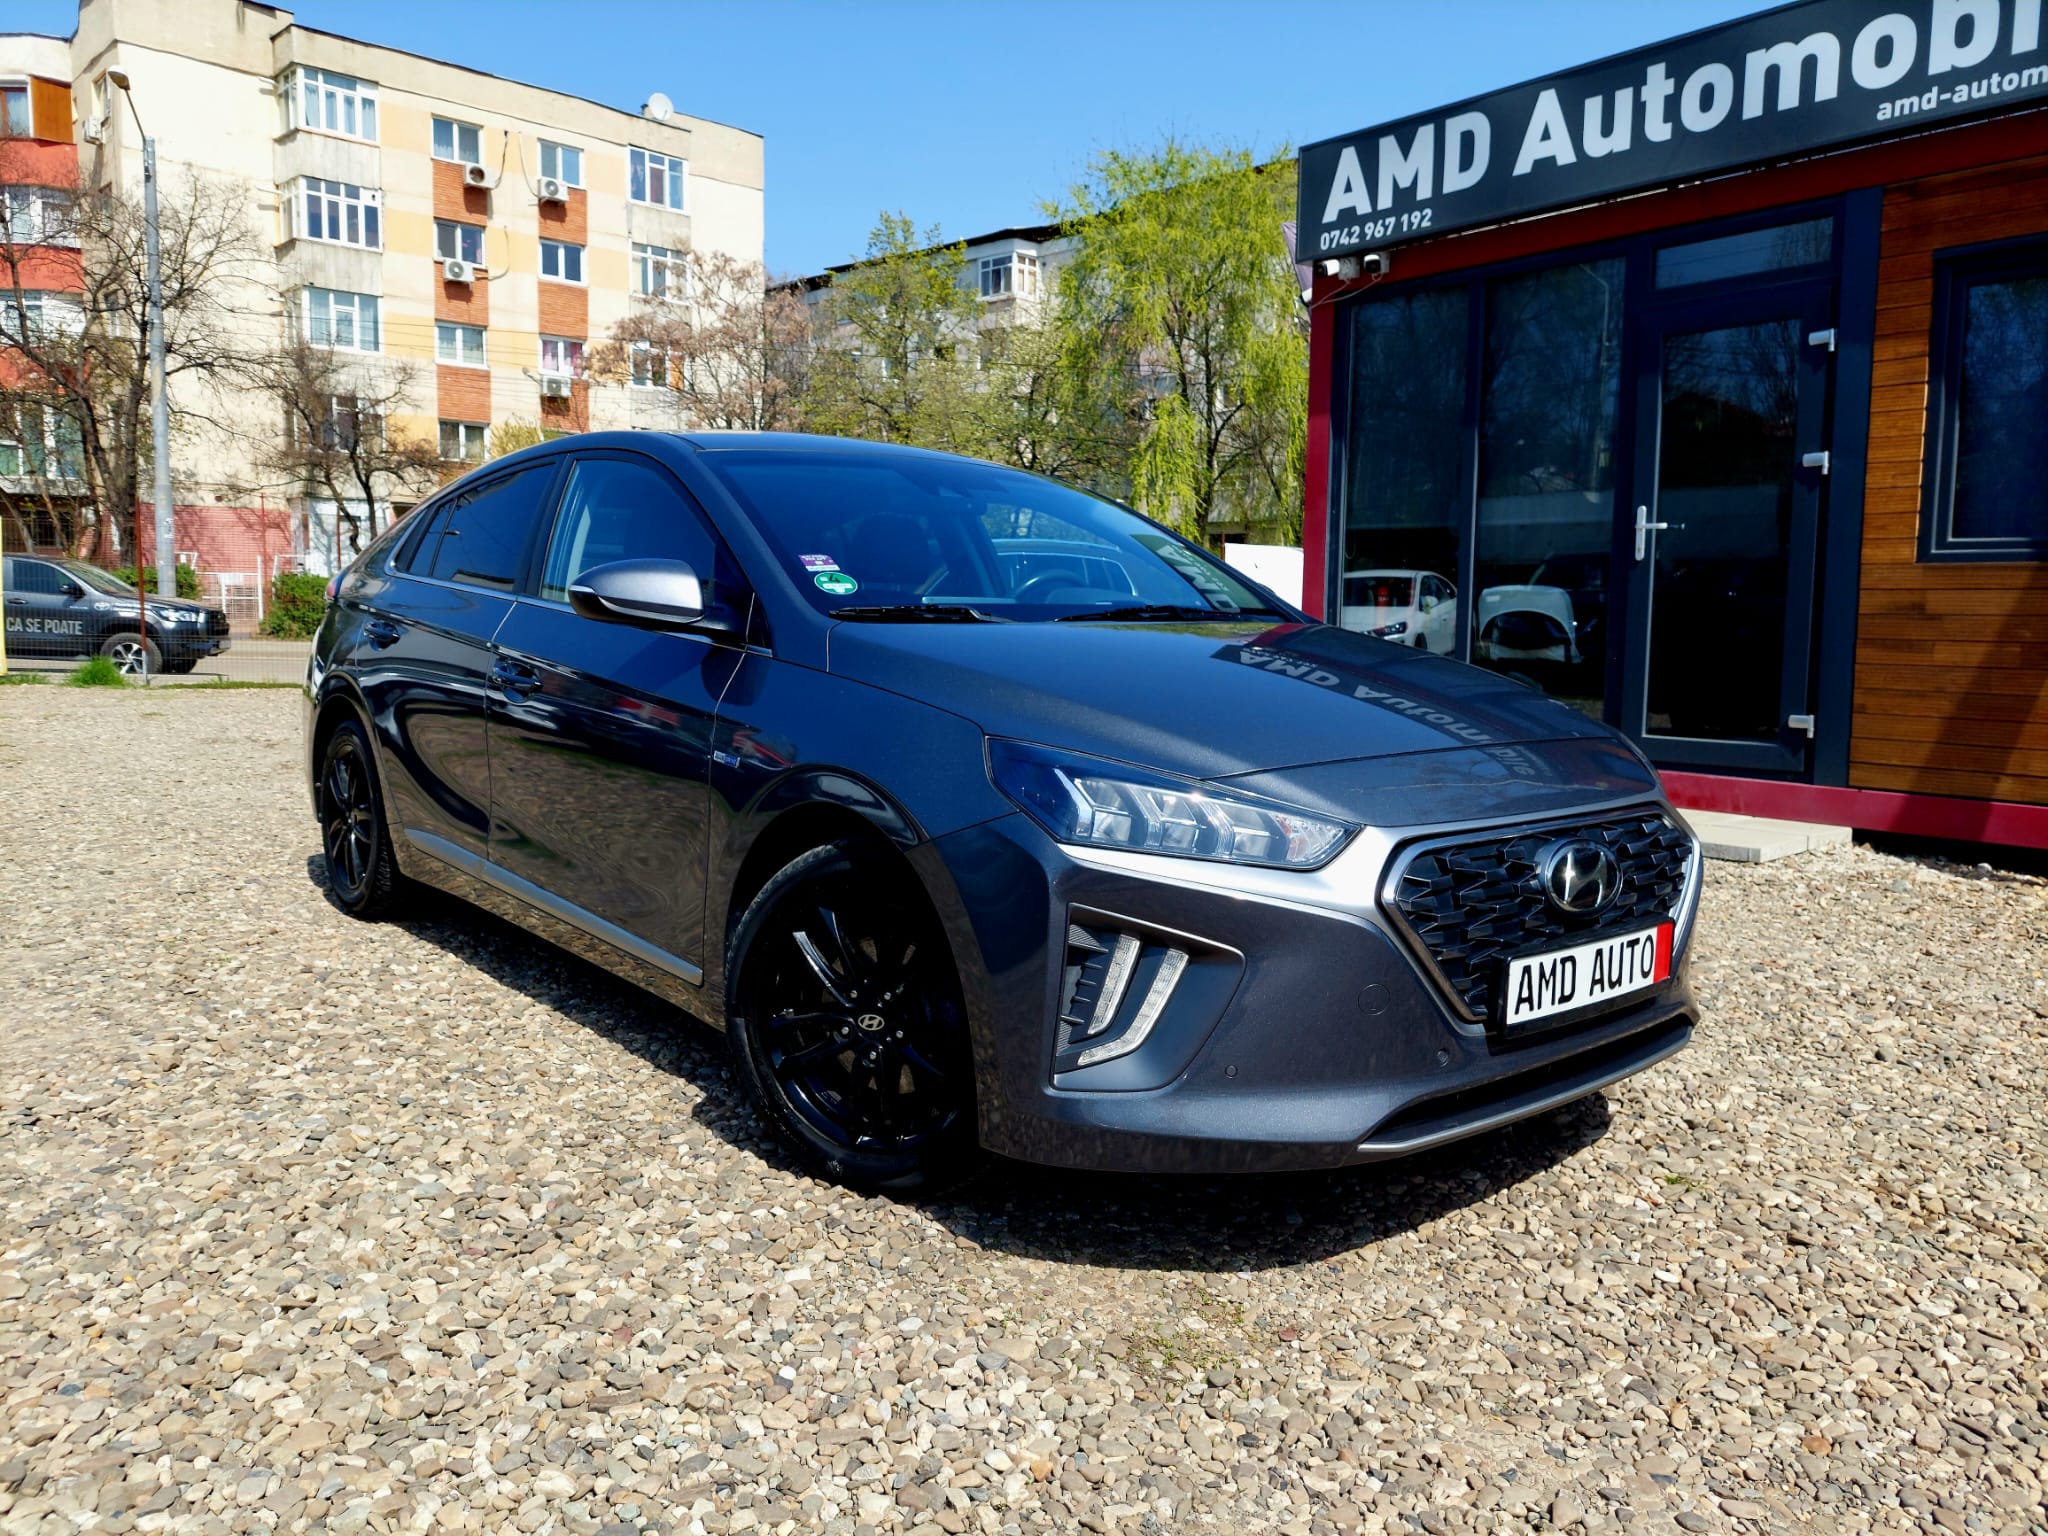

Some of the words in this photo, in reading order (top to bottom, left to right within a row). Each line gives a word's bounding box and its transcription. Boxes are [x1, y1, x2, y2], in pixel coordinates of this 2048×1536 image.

[1876, 64, 2048, 121] amd-autom
[1321, 111, 1491, 224] AMD
[1320, 225, 1360, 250] 0742
[1364, 216, 1396, 240] 967
[1401, 208, 1432, 232] 192
[25, 618, 42, 633] SE
[44, 619, 83, 635] POATE
[1514, 954, 1577, 1015] AMD
[1589, 934, 1655, 997] AUTO
